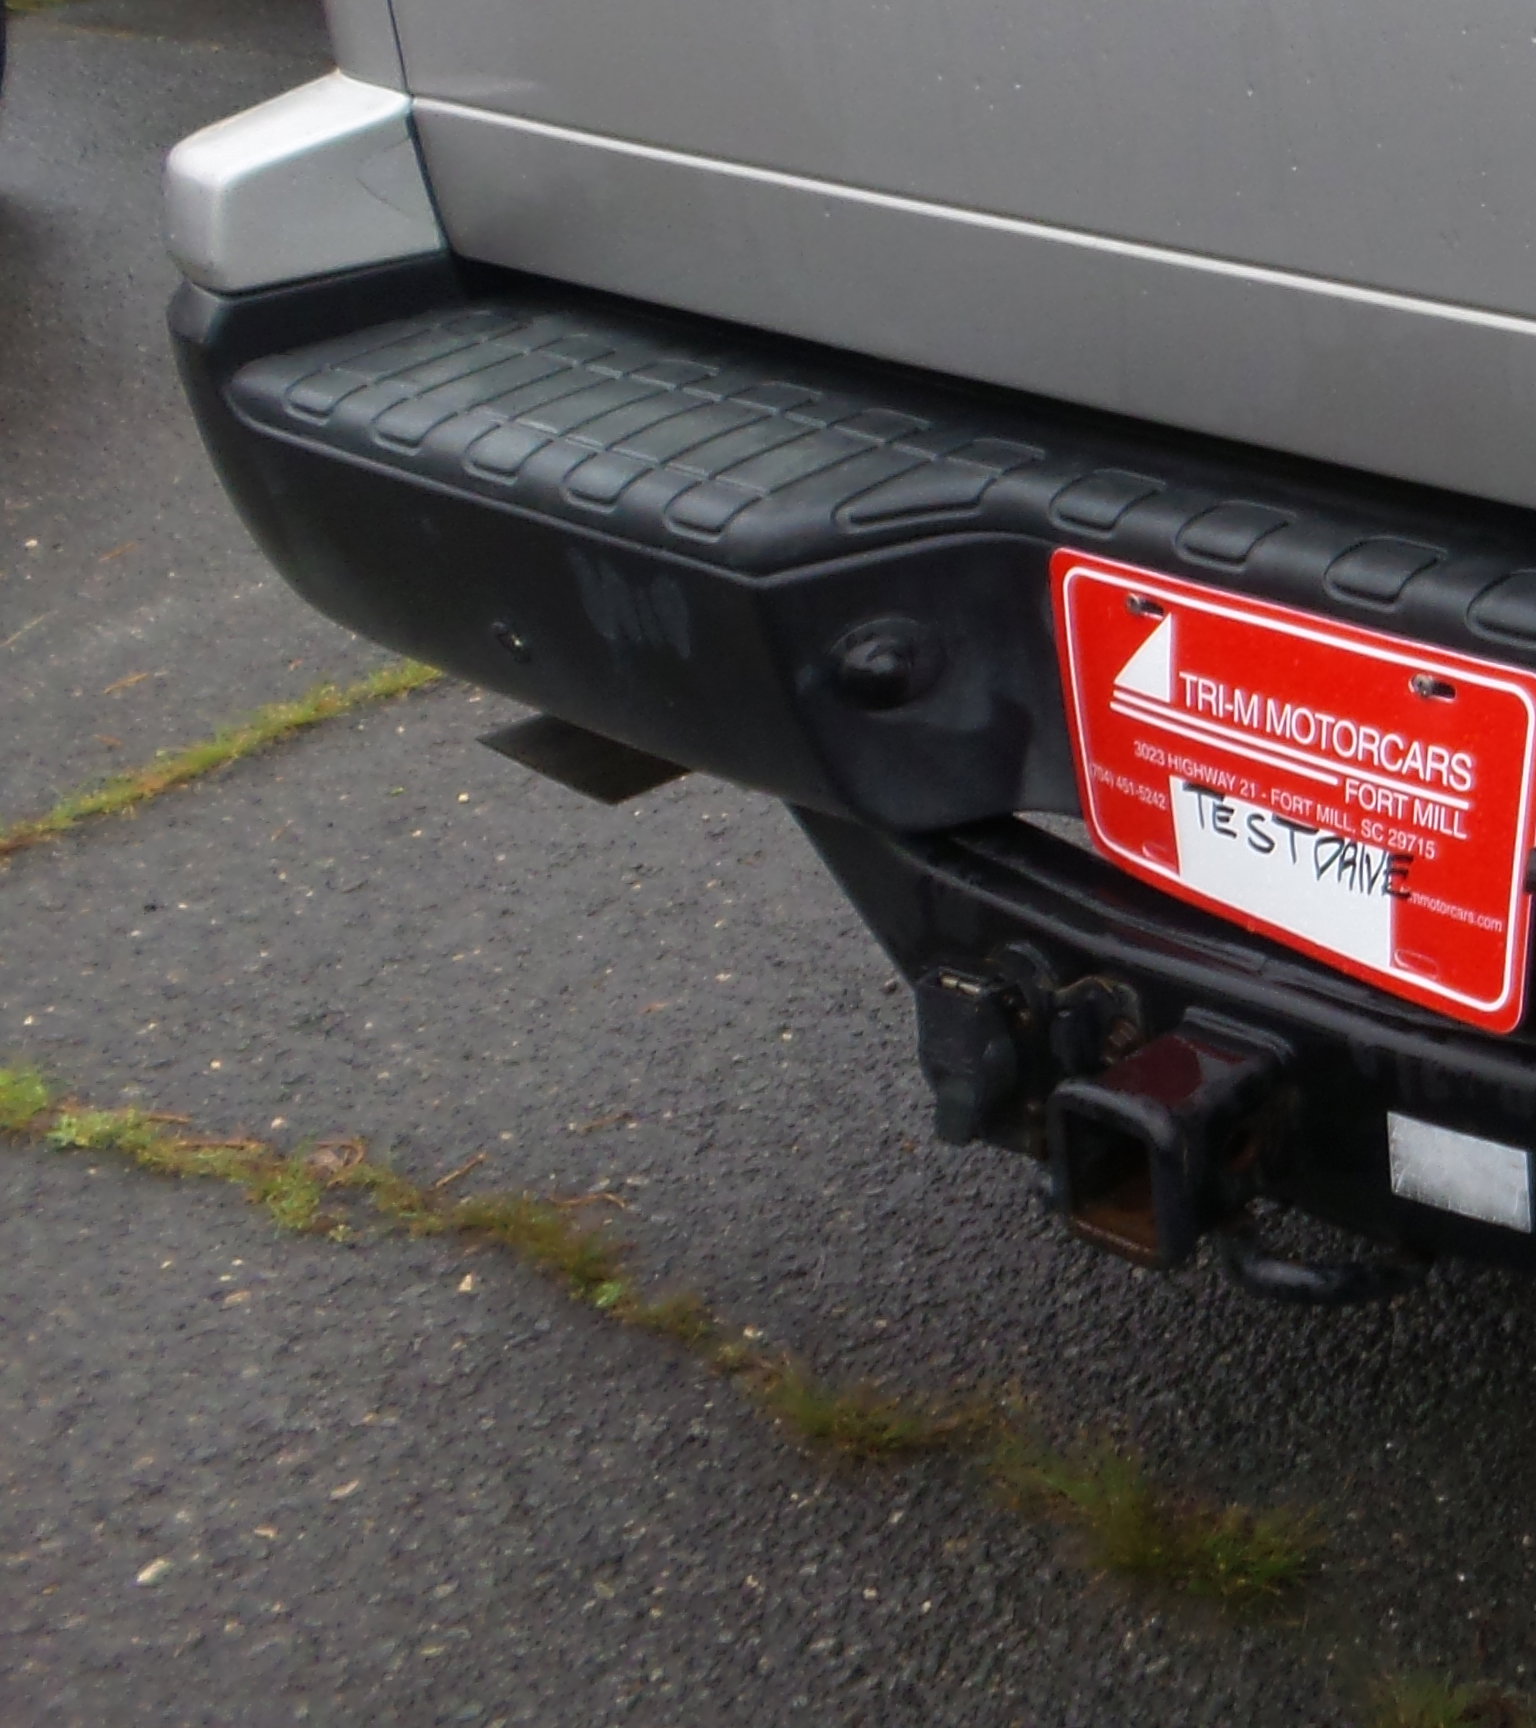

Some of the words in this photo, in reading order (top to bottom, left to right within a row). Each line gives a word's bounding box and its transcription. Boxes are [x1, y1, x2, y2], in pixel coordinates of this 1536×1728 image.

[1178, 671, 1260, 730] TRI-M
[1265, 697, 1474, 792] MOTORCARS
[1133, 739, 1166, 767] 3023
[1167, 752, 1237, 792] HIGHWAY
[1240, 778, 1256, 798] 21
[1270, 787, 1313, 817] FORT
[1360, 820, 1385, 843] SC
[1387, 828, 1436, 860] 29715
[1182, 780, 1320, 865] TEST
[1344, 777, 1409, 821] FORT
[1413, 798, 1469, 840] MILL
